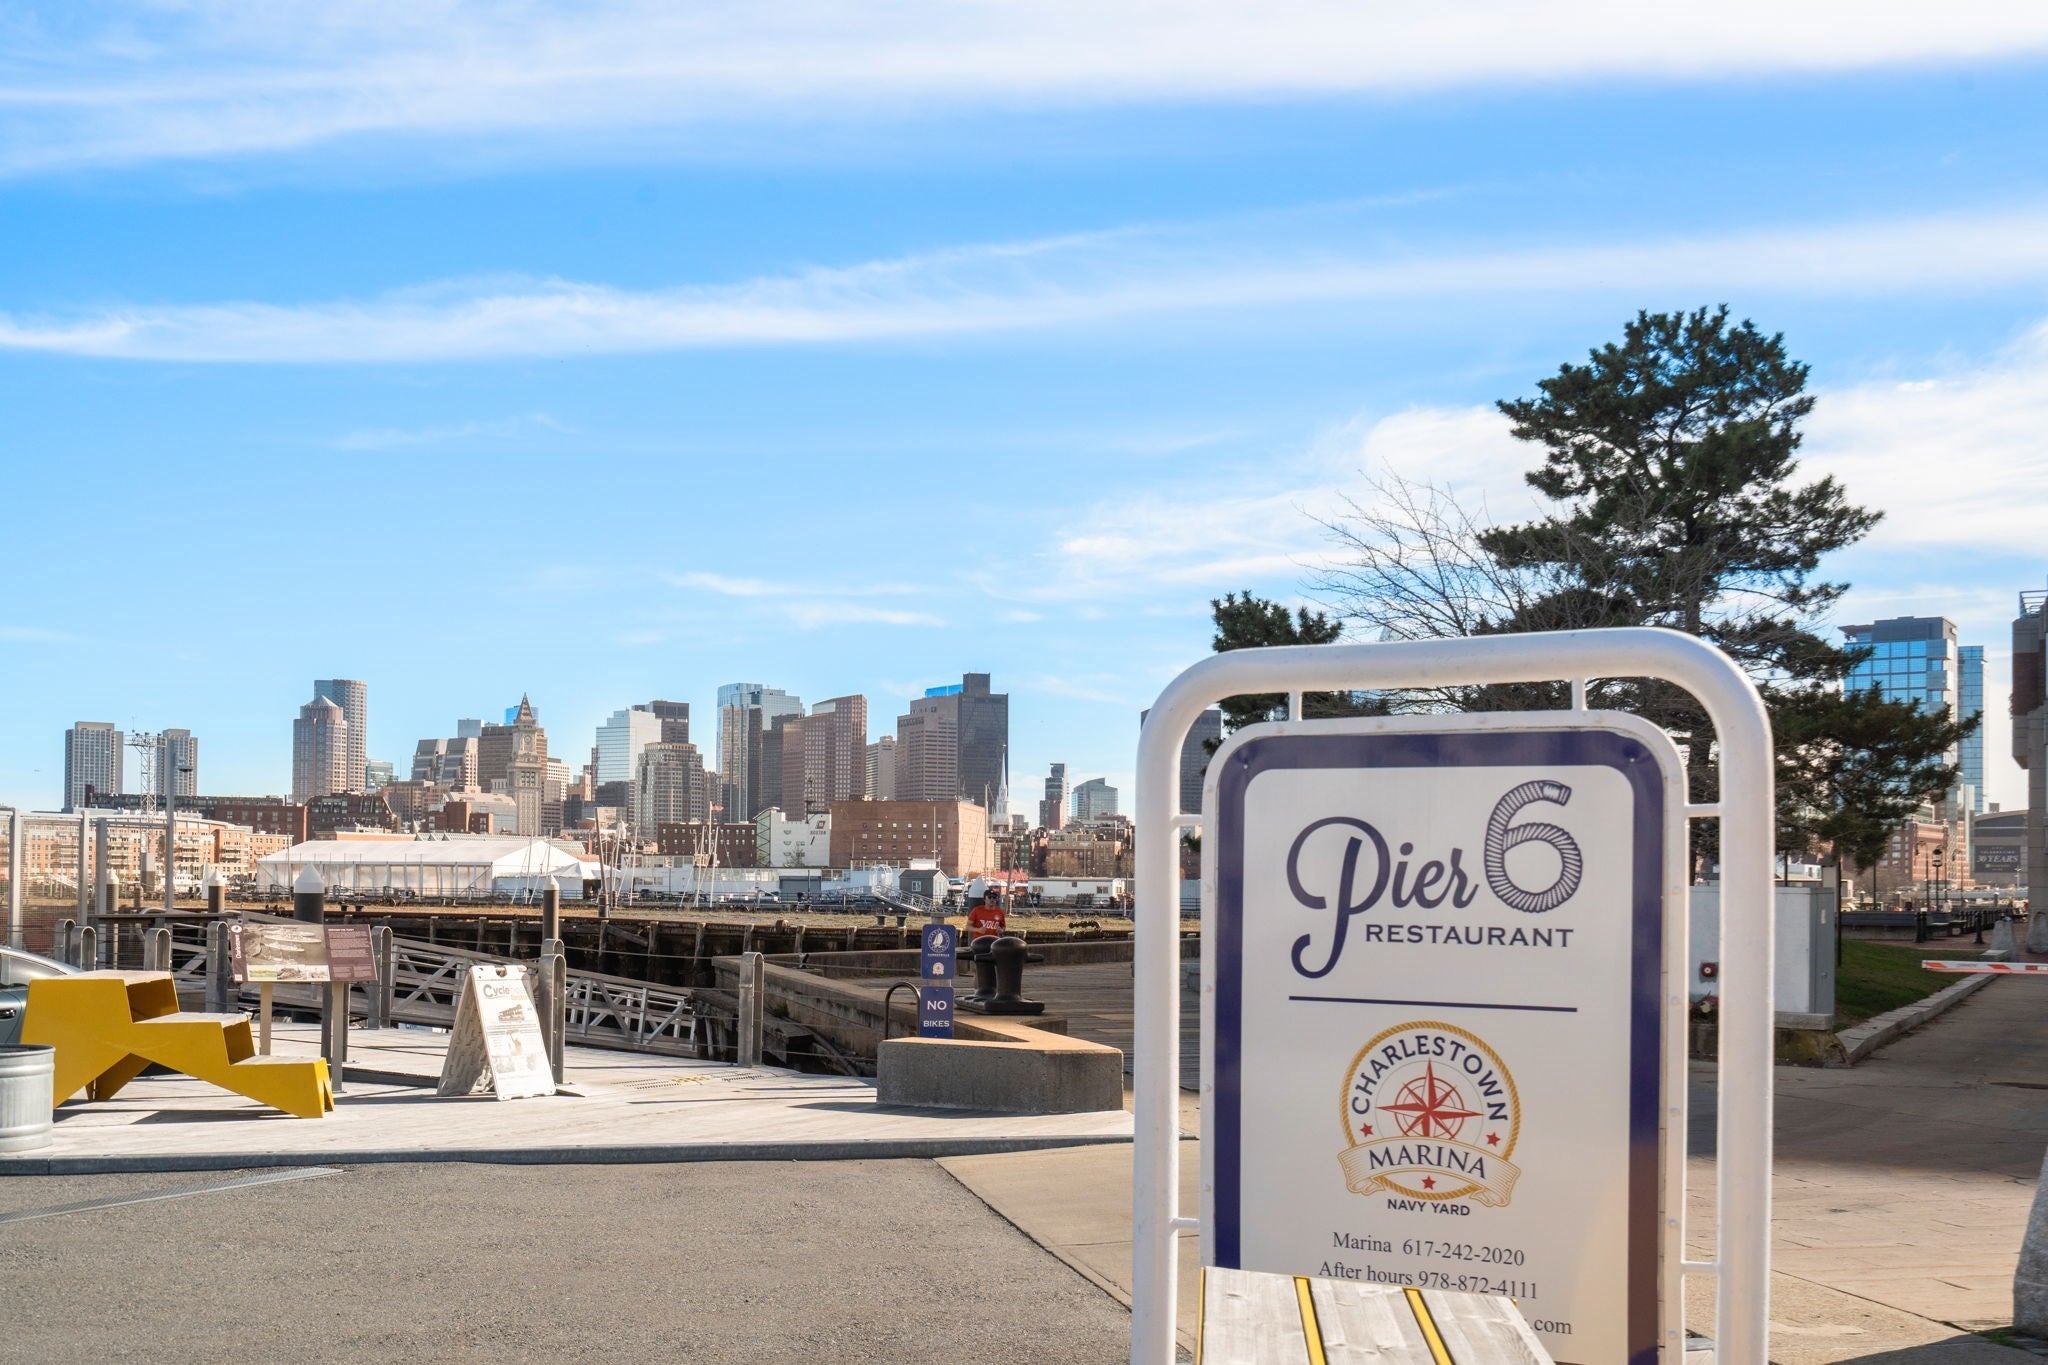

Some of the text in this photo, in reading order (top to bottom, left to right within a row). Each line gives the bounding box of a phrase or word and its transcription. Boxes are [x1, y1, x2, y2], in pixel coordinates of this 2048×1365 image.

[1988, 855, 2018, 863] YEARS
[1286, 779, 1583, 979] Pier 6
[1365, 924, 1574, 948] RESTAURANT
[927, 1000, 947, 1011] NO
[923, 1020, 950, 1028] BIKES
[1351, 1035, 1509, 1121] CHARLESTOWN
[1368, 1144, 1488, 1180] MARINA
[1387, 1198, 1471, 1217] NAVY YARD
[1332, 1231, 1525, 1266] Marina 617-242-2020
[1318, 1260, 1537, 1300] After hours 978-872-4111
